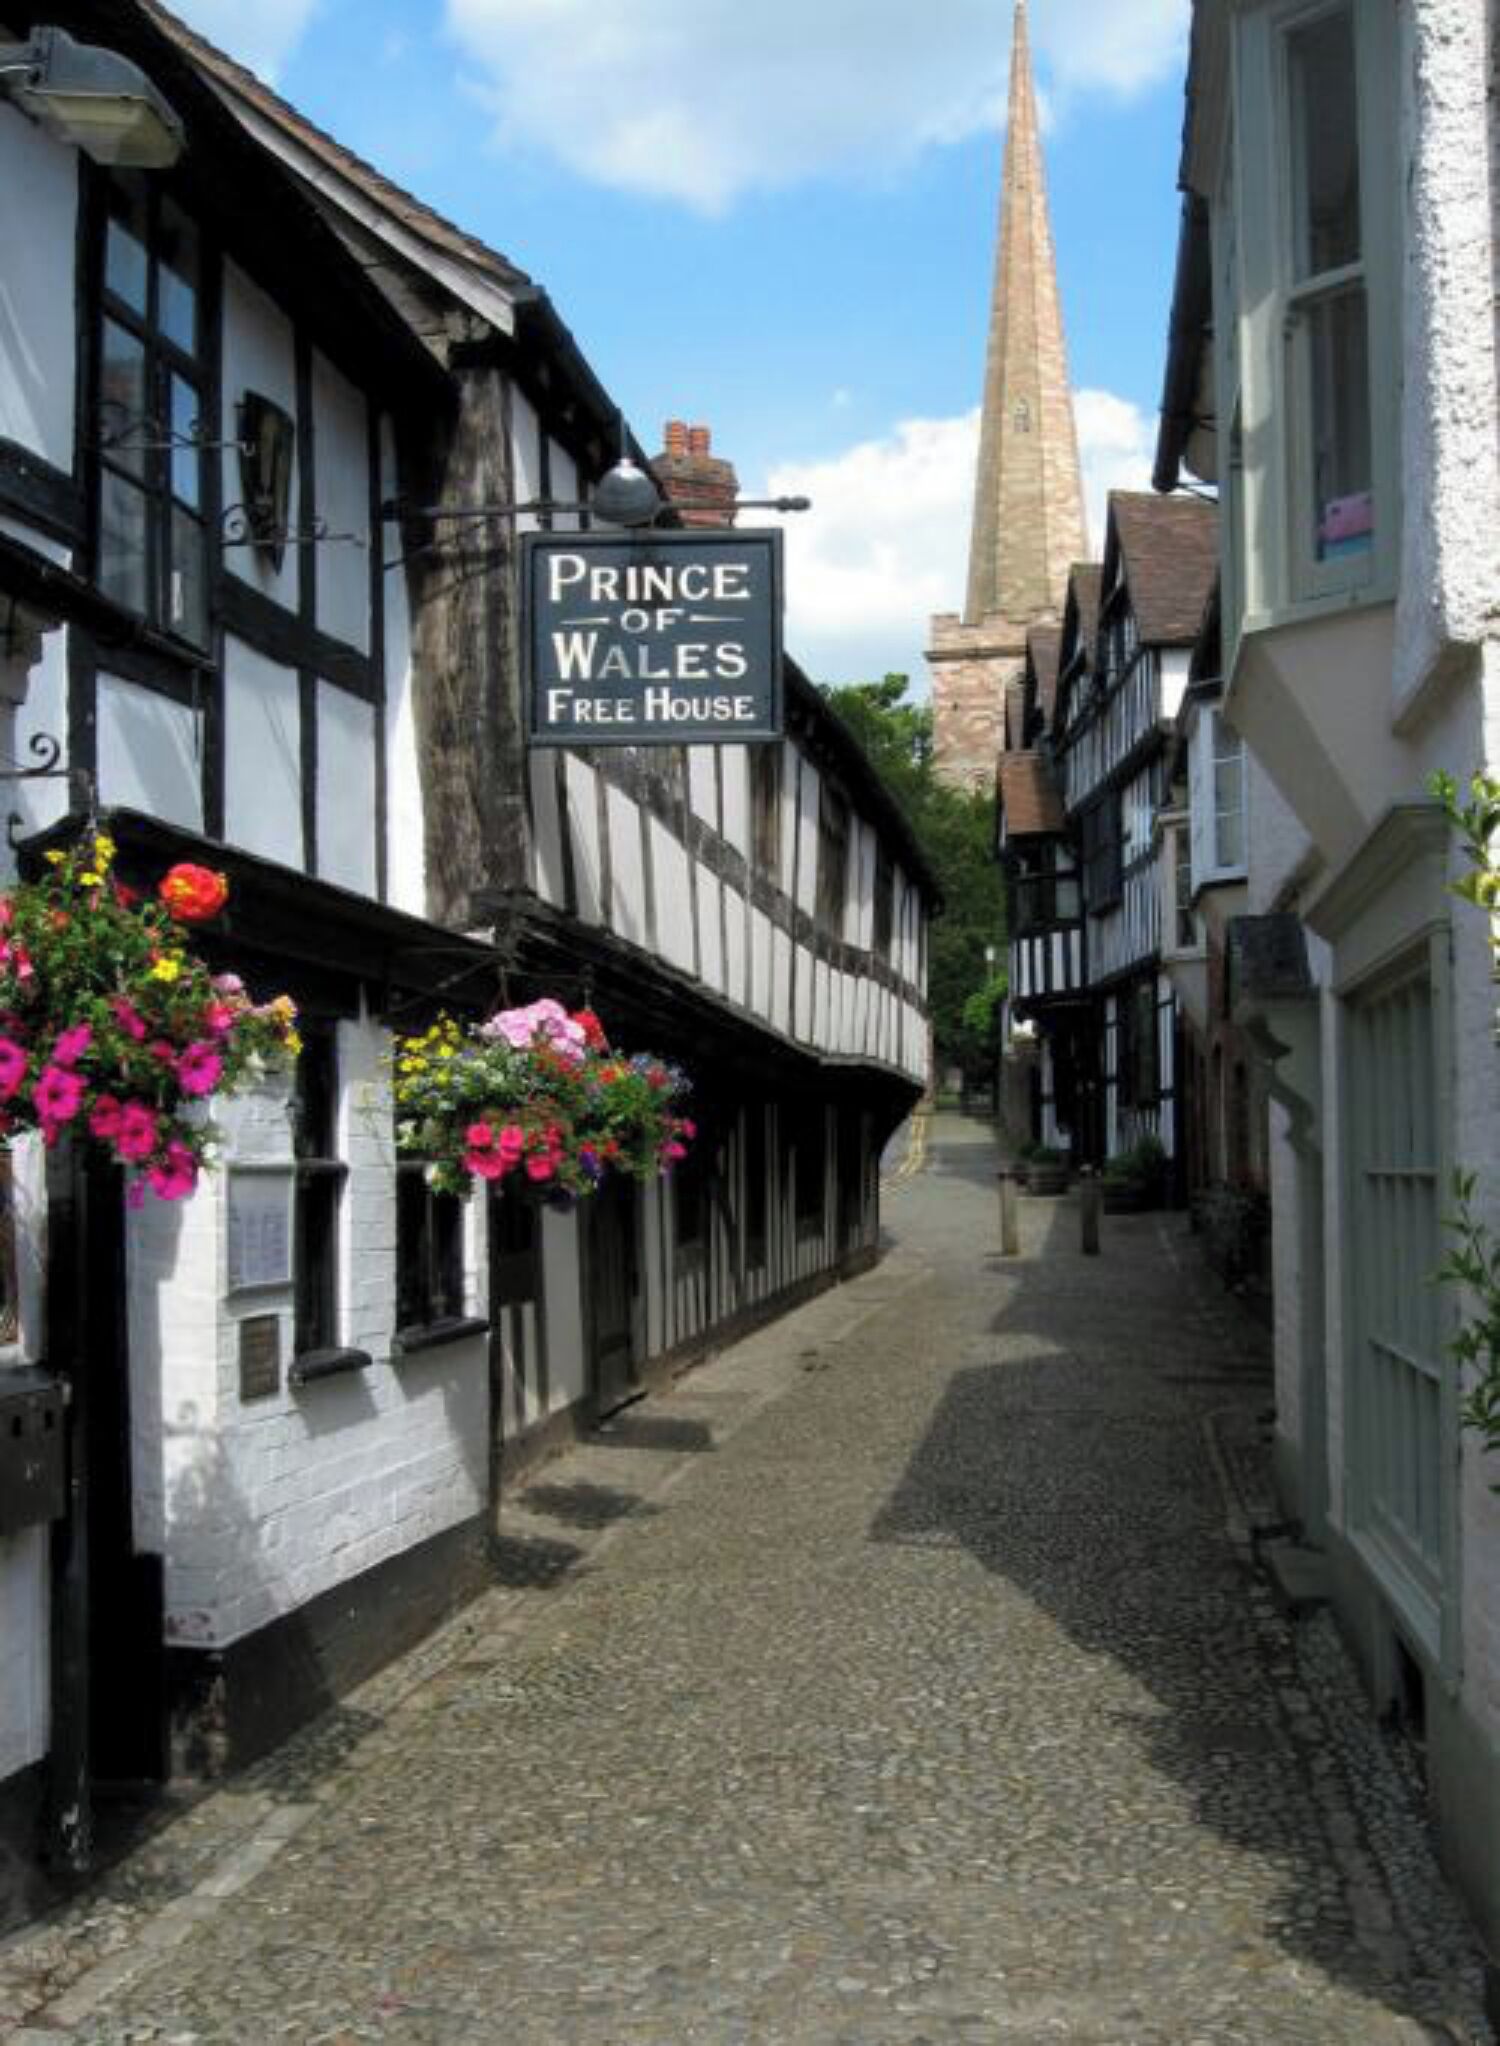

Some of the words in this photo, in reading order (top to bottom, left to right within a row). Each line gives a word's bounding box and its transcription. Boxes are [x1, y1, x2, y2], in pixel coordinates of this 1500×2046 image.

[549, 554, 750, 601] PRINCE
[620, 608, 685, 632] OF
[551, 631, 748, 680] WALES
[547, 689, 634, 723] FREE
[644, 686, 755, 721] HOUSE
